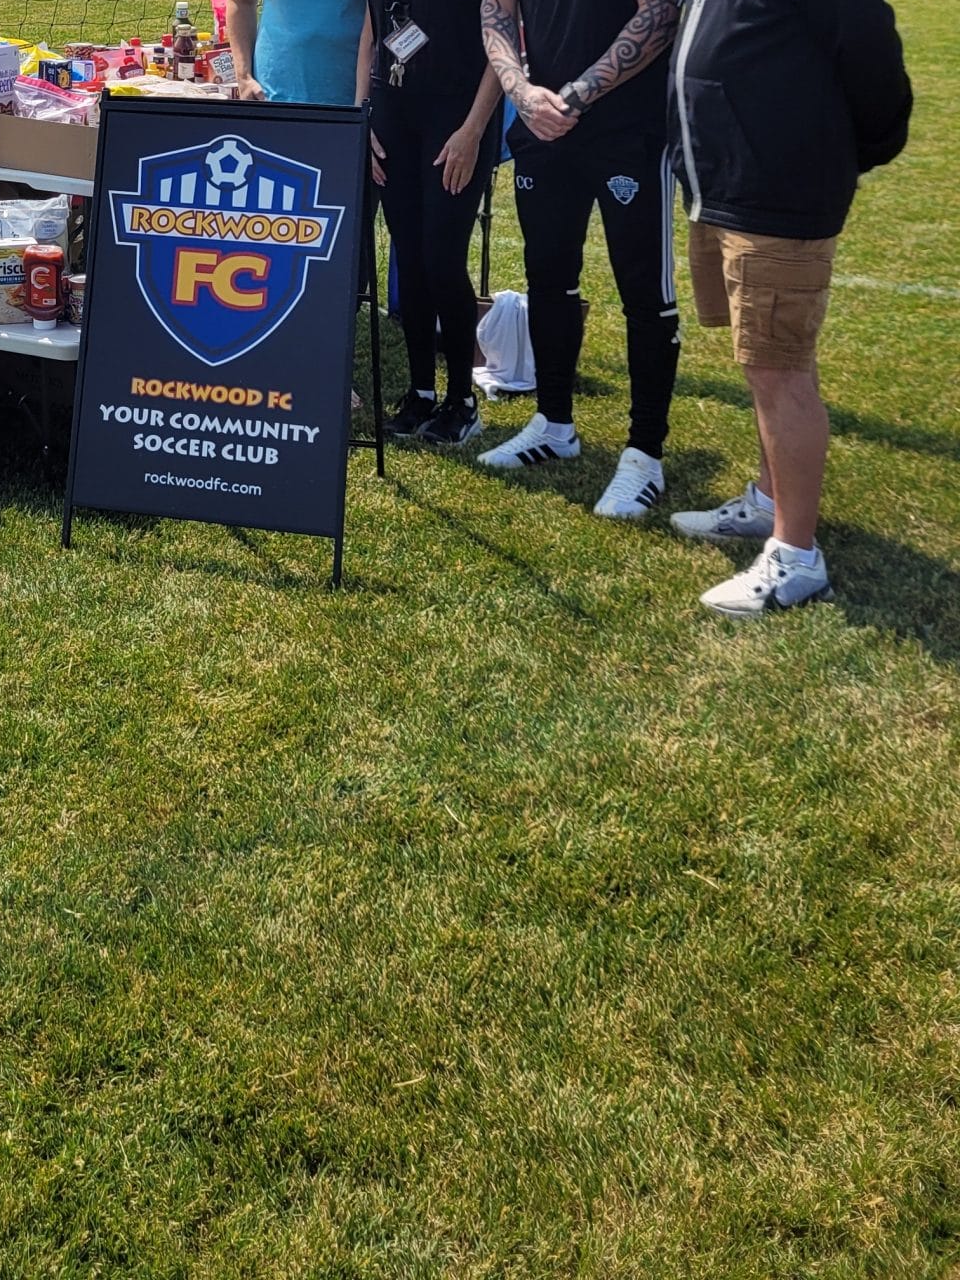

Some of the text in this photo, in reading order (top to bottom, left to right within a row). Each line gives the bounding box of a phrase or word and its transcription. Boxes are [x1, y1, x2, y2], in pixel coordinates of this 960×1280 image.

[516, 175, 534, 190] CC
[130, 206, 321, 243] ROCKWOOD
[172, 246, 271, 311] FC
[131, 377, 293, 411] ROCKWOOD FC
[99, 404, 320, 444] YOUR COMMUNITY
[133, 433, 279, 465] SOCCER CLUB
[144, 472, 262, 496] rockwoodfc.com
